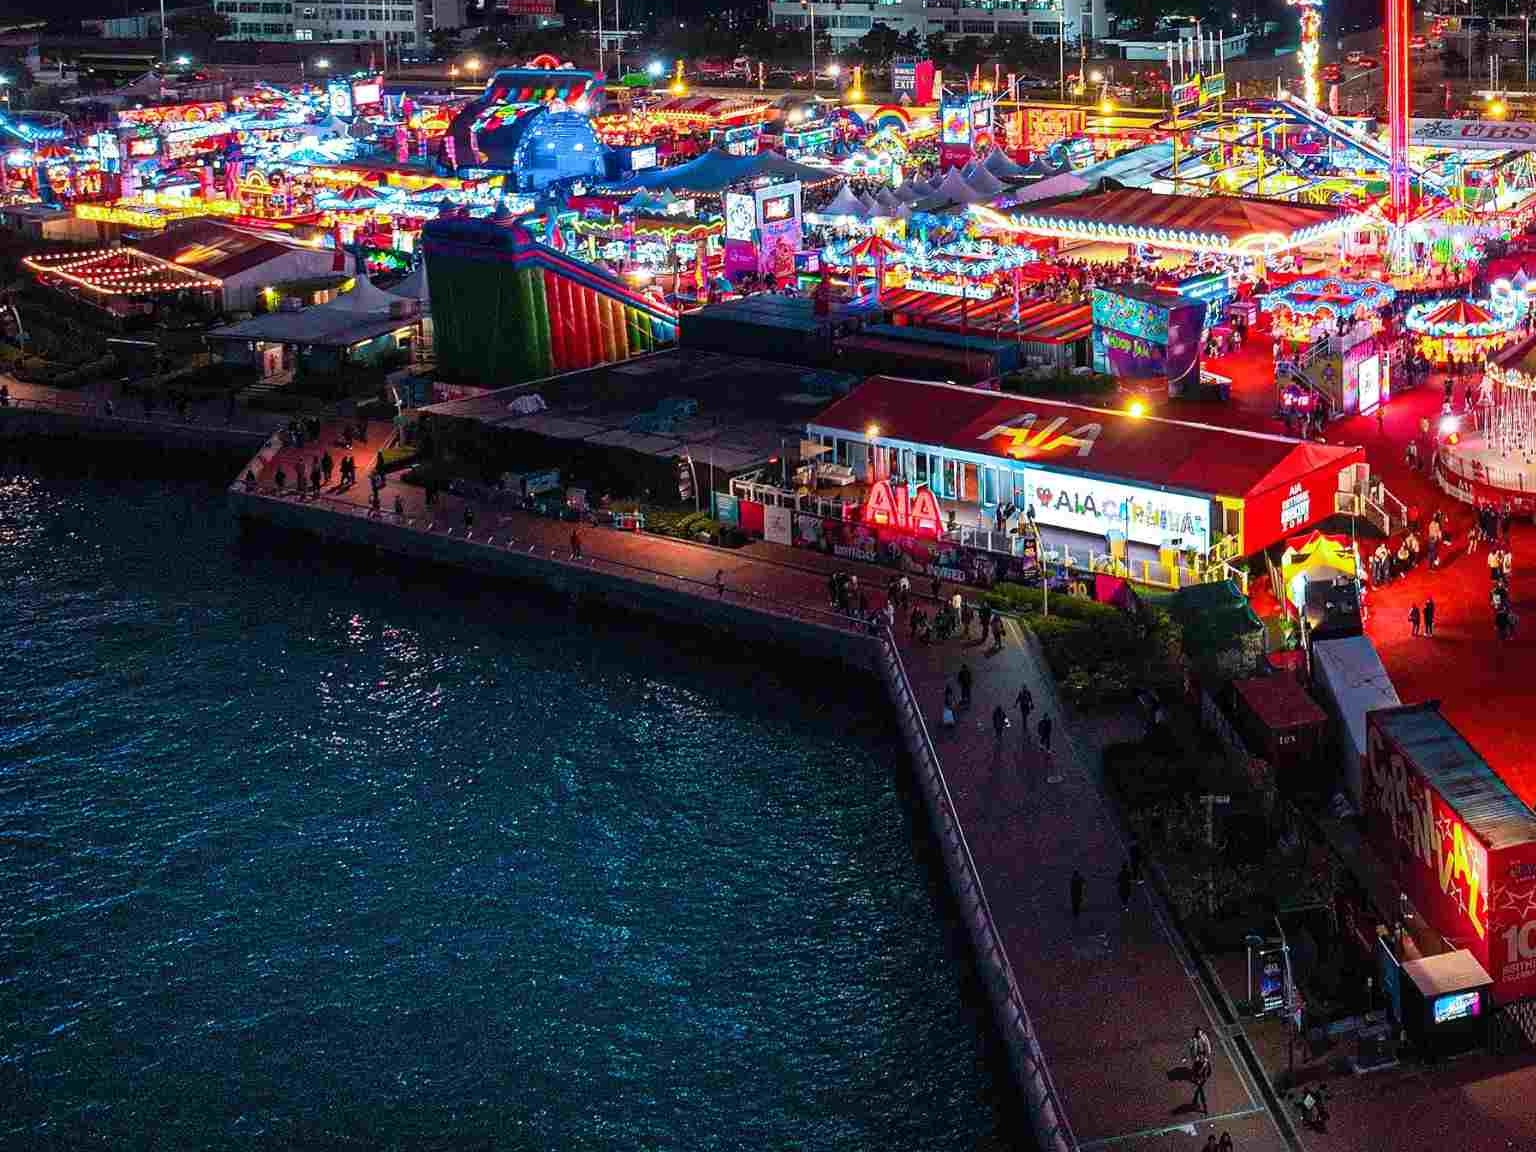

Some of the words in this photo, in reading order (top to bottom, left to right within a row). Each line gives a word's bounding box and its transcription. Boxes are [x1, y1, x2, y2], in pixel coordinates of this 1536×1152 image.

[894, 79, 914, 89] EXIT
[1460, 123, 1532, 140] UBS
[866, 480, 944, 538] AIA
